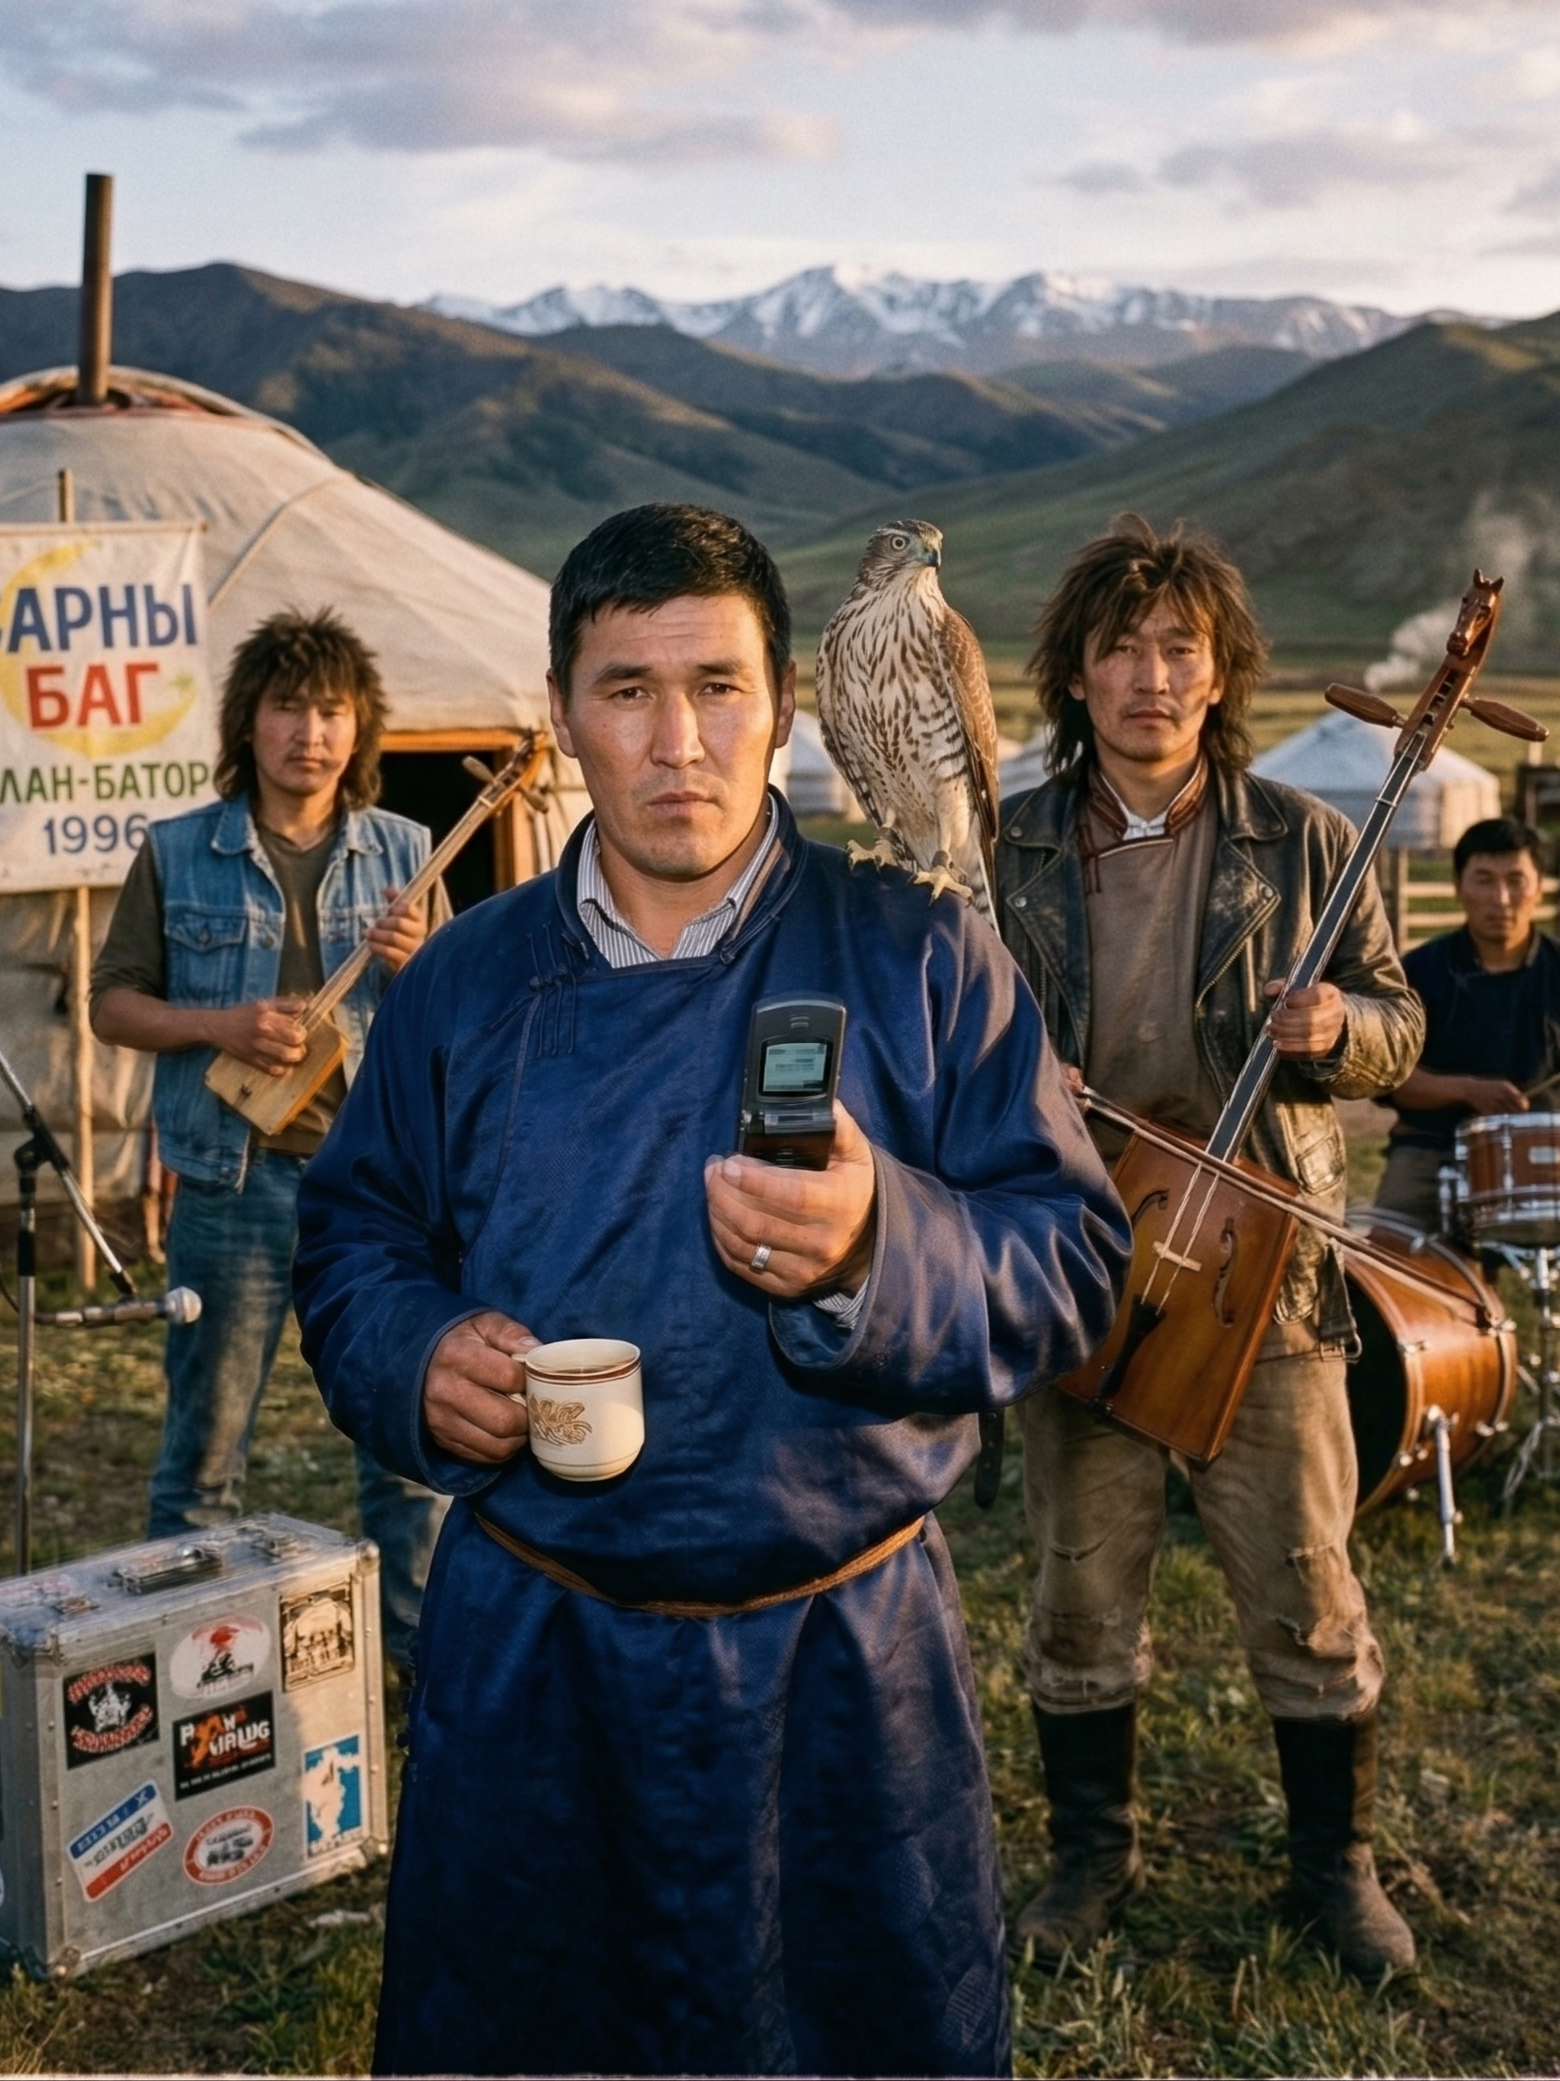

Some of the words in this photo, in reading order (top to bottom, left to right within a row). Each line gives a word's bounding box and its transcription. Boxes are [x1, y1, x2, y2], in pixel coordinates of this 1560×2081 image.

[0, 584, 197, 653] АРНЫ
[26, 662, 159, 730] БАГ
[42, 813, 150, 856] 1996
